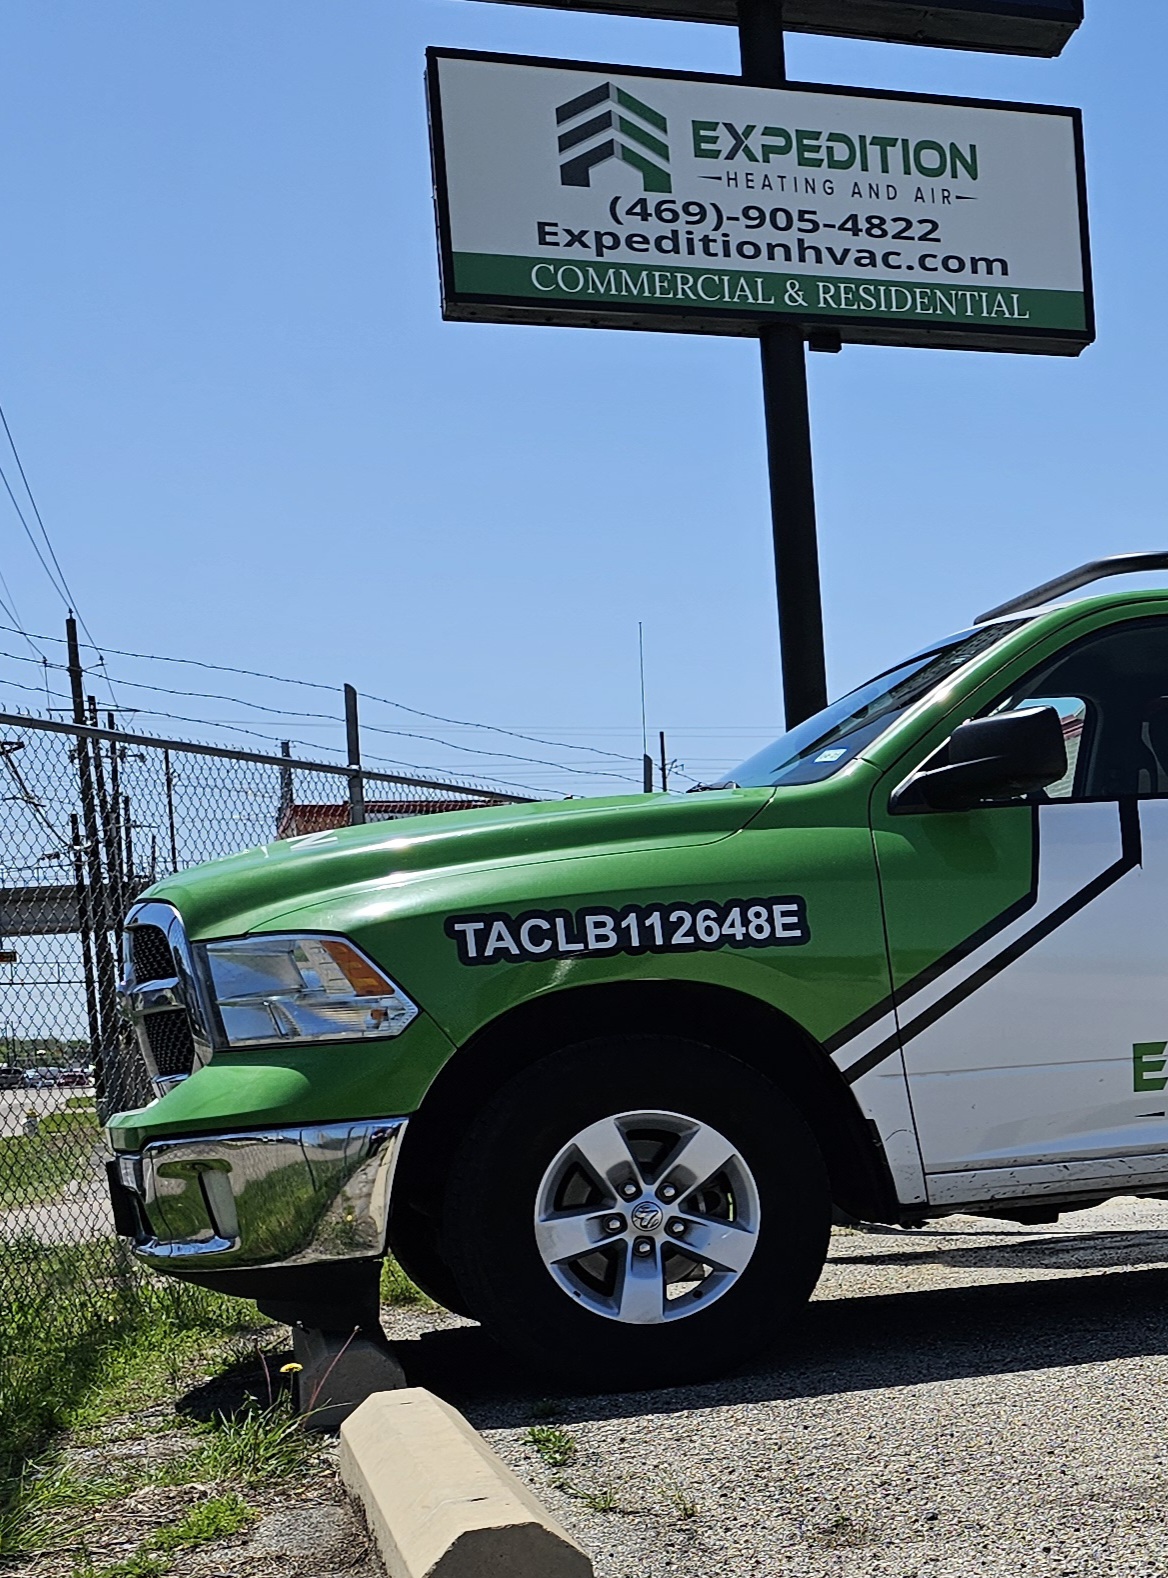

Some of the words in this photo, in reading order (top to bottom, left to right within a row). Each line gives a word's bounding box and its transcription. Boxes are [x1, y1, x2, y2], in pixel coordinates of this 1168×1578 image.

[691, 119, 978, 181] EXPEDITION
[725, 171, 836, 196] HEATING
[852, 180, 898, 202] AND
[915, 184, 953, 206] AIR
[609, 196, 942, 243] (469)-905-4822
[536, 220, 1010, 276] Expeditionhvac.com
[530, 263, 775, 305] COMMERCIAL
[784, 281, 808, 307] &
[816, 283, 1030, 320] RESIDENTIAL
[454, 903, 802, 958] TACLB112648E
